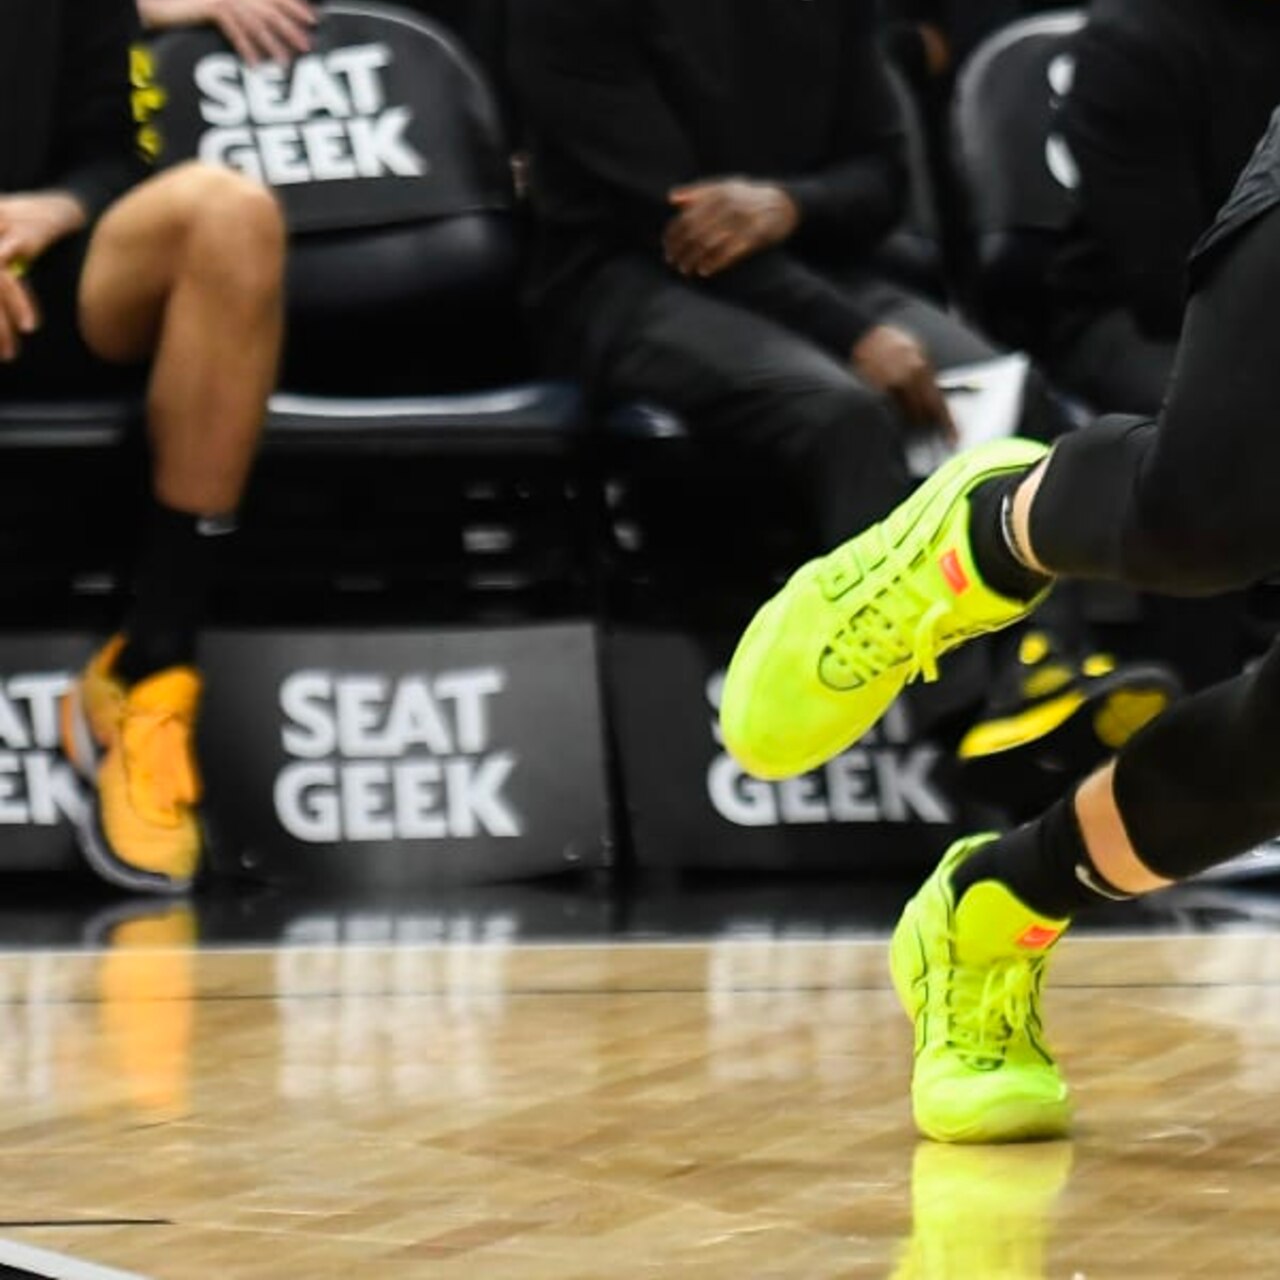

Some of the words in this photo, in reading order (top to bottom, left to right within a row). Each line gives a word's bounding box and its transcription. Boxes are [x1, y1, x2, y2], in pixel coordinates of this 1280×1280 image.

[194, 42, 393, 127] SEAT
[198, 106, 426, 186] GEEK
[279, 668, 507, 759] SEAT
[273, 754, 524, 843] GEEK
[706, 742, 956, 827] GEEK
